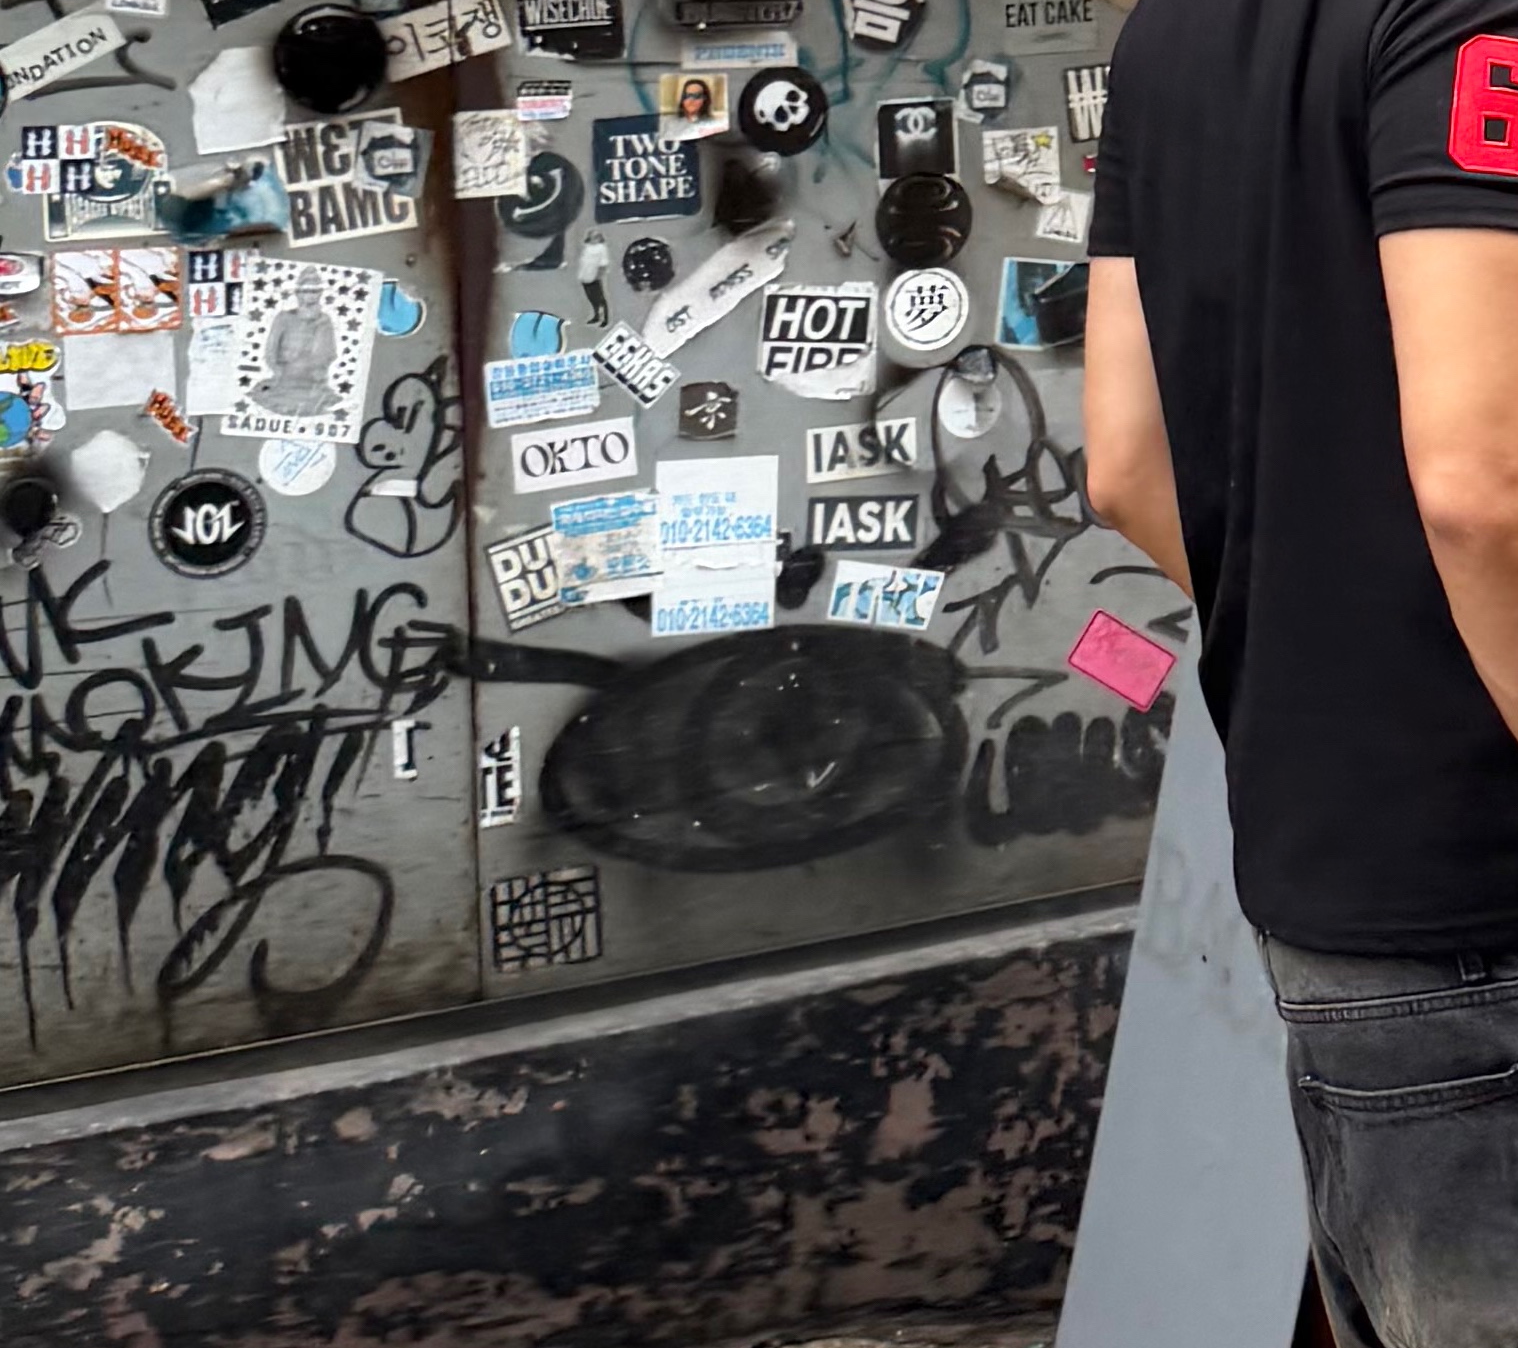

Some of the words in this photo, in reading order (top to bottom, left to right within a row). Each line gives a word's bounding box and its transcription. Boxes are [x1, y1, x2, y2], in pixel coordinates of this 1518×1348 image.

[1005, 2, 1037, 28] EAT
[605, 153, 688, 181] TONE
[599, 175, 697, 205] SHAPE
[769, 296, 866, 341] HOT
[905, 284, 950, 333] 夢
[520, 428, 631, 479] OKTO
